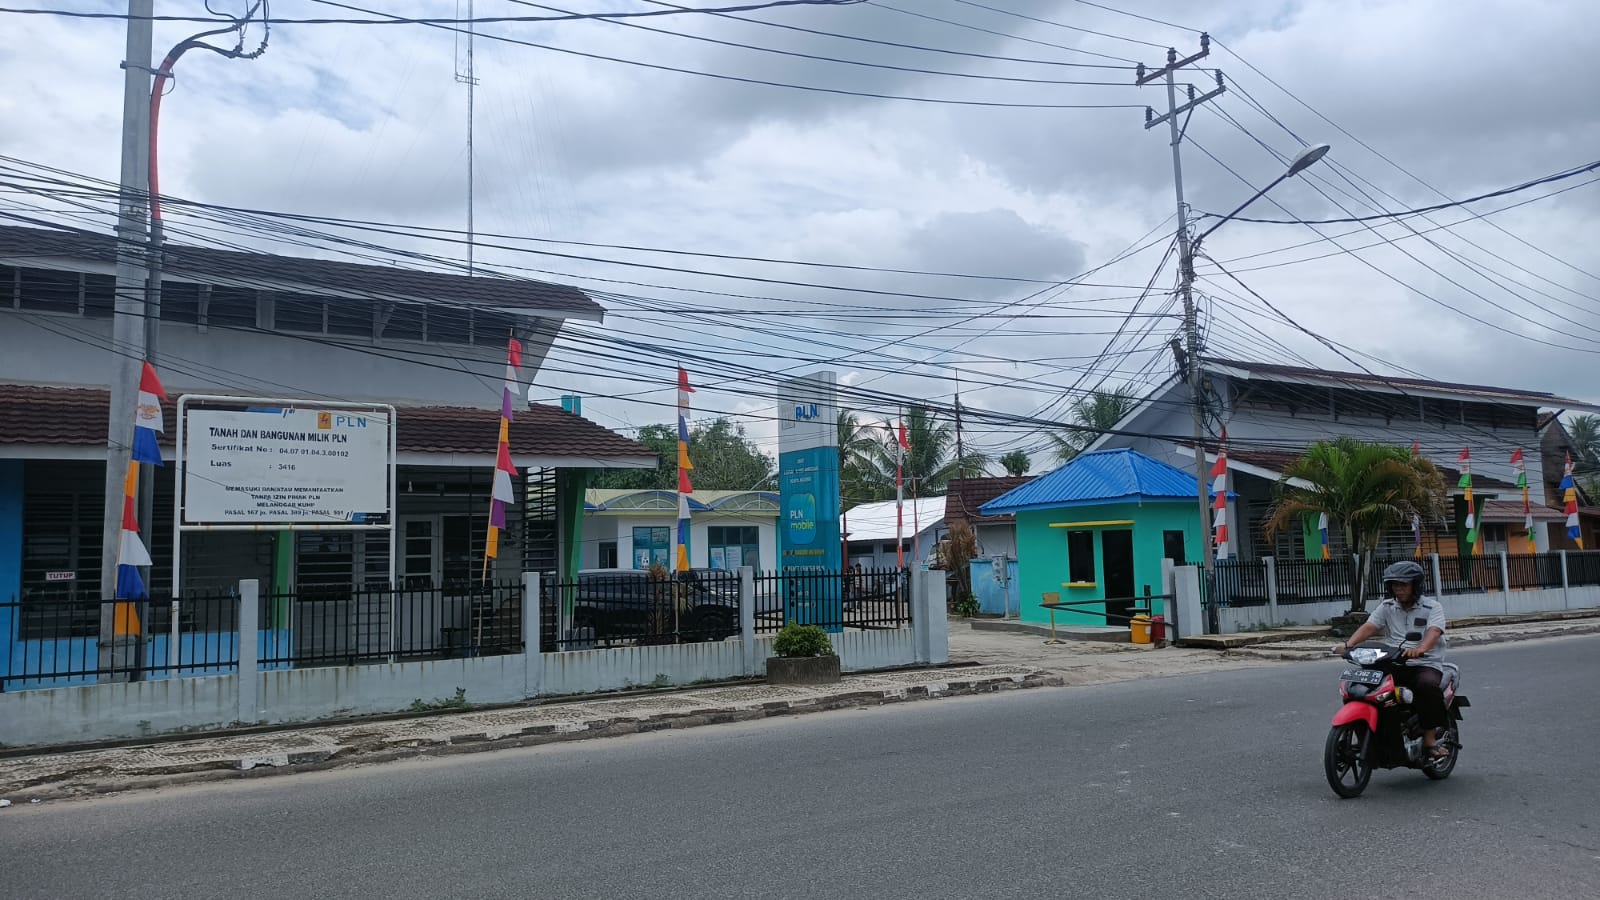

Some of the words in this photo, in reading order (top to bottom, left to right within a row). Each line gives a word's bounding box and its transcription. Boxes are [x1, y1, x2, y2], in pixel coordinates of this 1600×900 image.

[795, 403, 818, 420] PLN
[336, 416, 367, 428] PLN
[209, 427, 238, 438] TANAH
[240, 429, 258, 439] DAN
[260, 430, 306, 441] BANGUNAN
[307, 432, 330, 442] MILIK
[332, 433, 347, 443] PLN
[211, 443, 253, 452] Sertifikat
[210, 459, 232, 467] Luas
[790, 509, 804, 519] PLN
[790, 520, 814, 531] mobile
